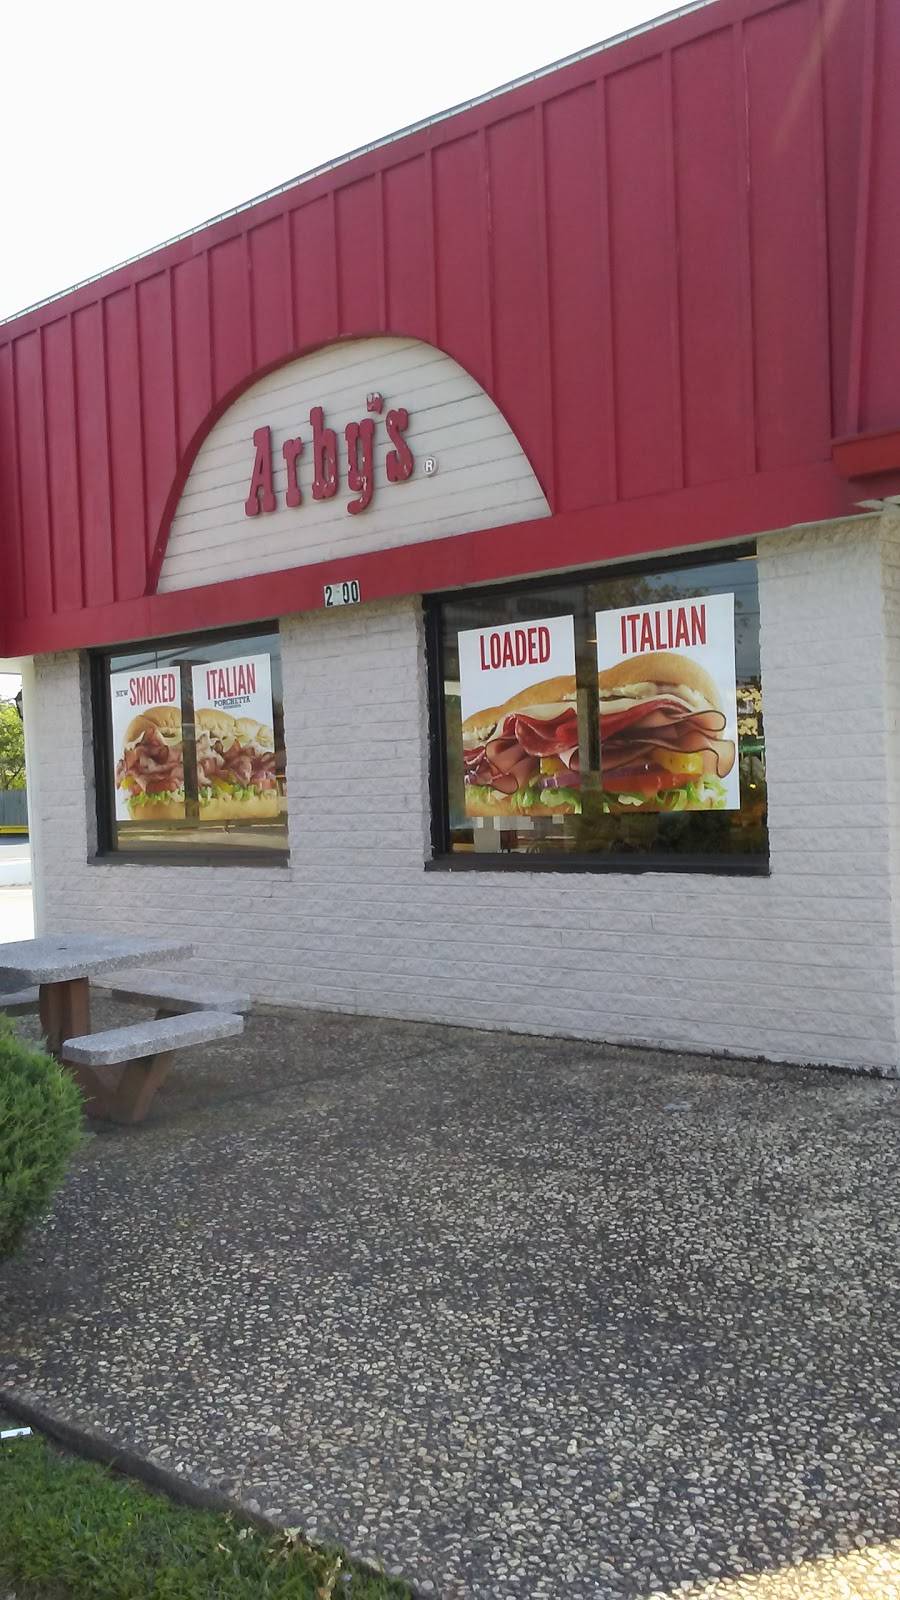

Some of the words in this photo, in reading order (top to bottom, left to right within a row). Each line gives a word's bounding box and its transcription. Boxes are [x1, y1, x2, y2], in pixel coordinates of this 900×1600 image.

[245, 391, 415, 517] Arby's
[479, 626, 551, 671] LOADED
[620, 604, 707, 654] ITALIAN
[129, 673, 176, 706] SMOKED
[206, 663, 257, 700] ITALIAN
